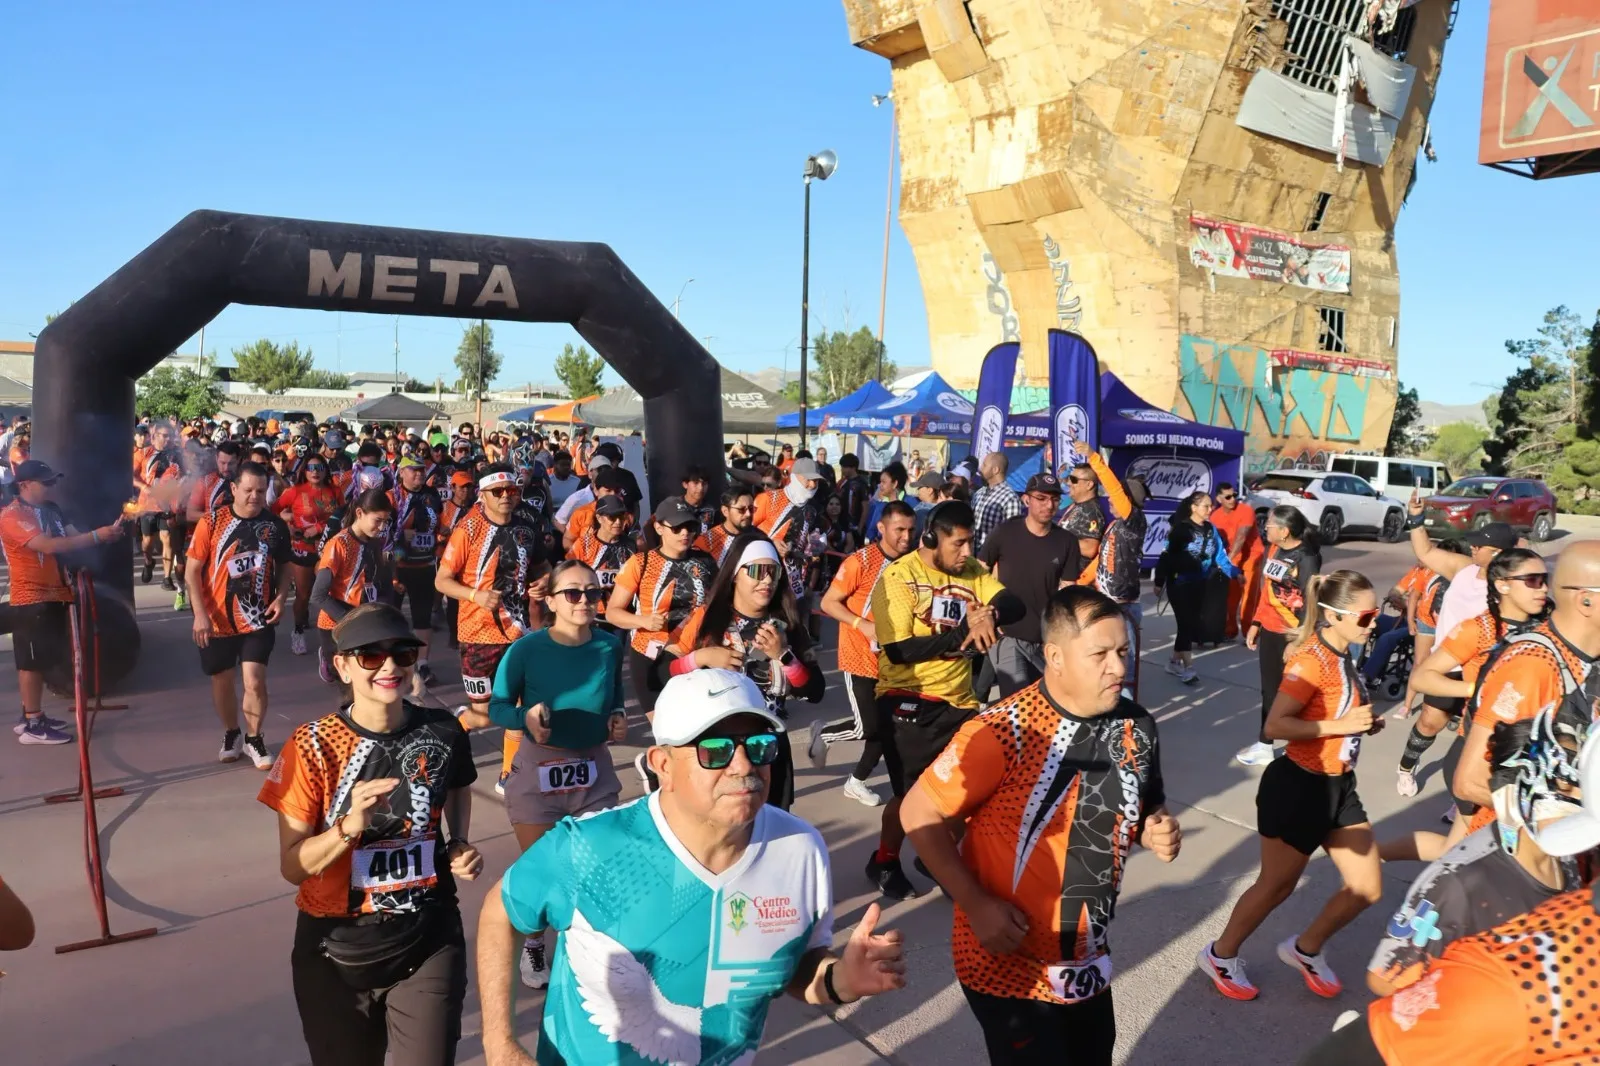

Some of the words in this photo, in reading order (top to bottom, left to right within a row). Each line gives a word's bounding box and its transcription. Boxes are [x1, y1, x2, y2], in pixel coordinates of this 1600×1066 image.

[307, 248, 519, 309] META
[721, 392, 764, 401] WER
[1014, 426, 1025, 436] SU
[1025, 426, 1049, 437] MEJOR
[1125, 433, 1155, 445] SOMOS
[1156, 433, 1167, 444] SU
[1168, 434, 1194, 446] MEJOR
[1195, 436, 1224, 451] OPCIÓN
[1147, 461, 1205, 494] González
[416, 535, 432, 546] 314
[1266, 562, 1283, 577] 024
[464, 679, 486, 695] 306
[548, 763, 590, 788] 029
[368, 844, 423, 883] 401
[753, 896, 790, 908] Centro
[757, 907, 797, 919] Médico
